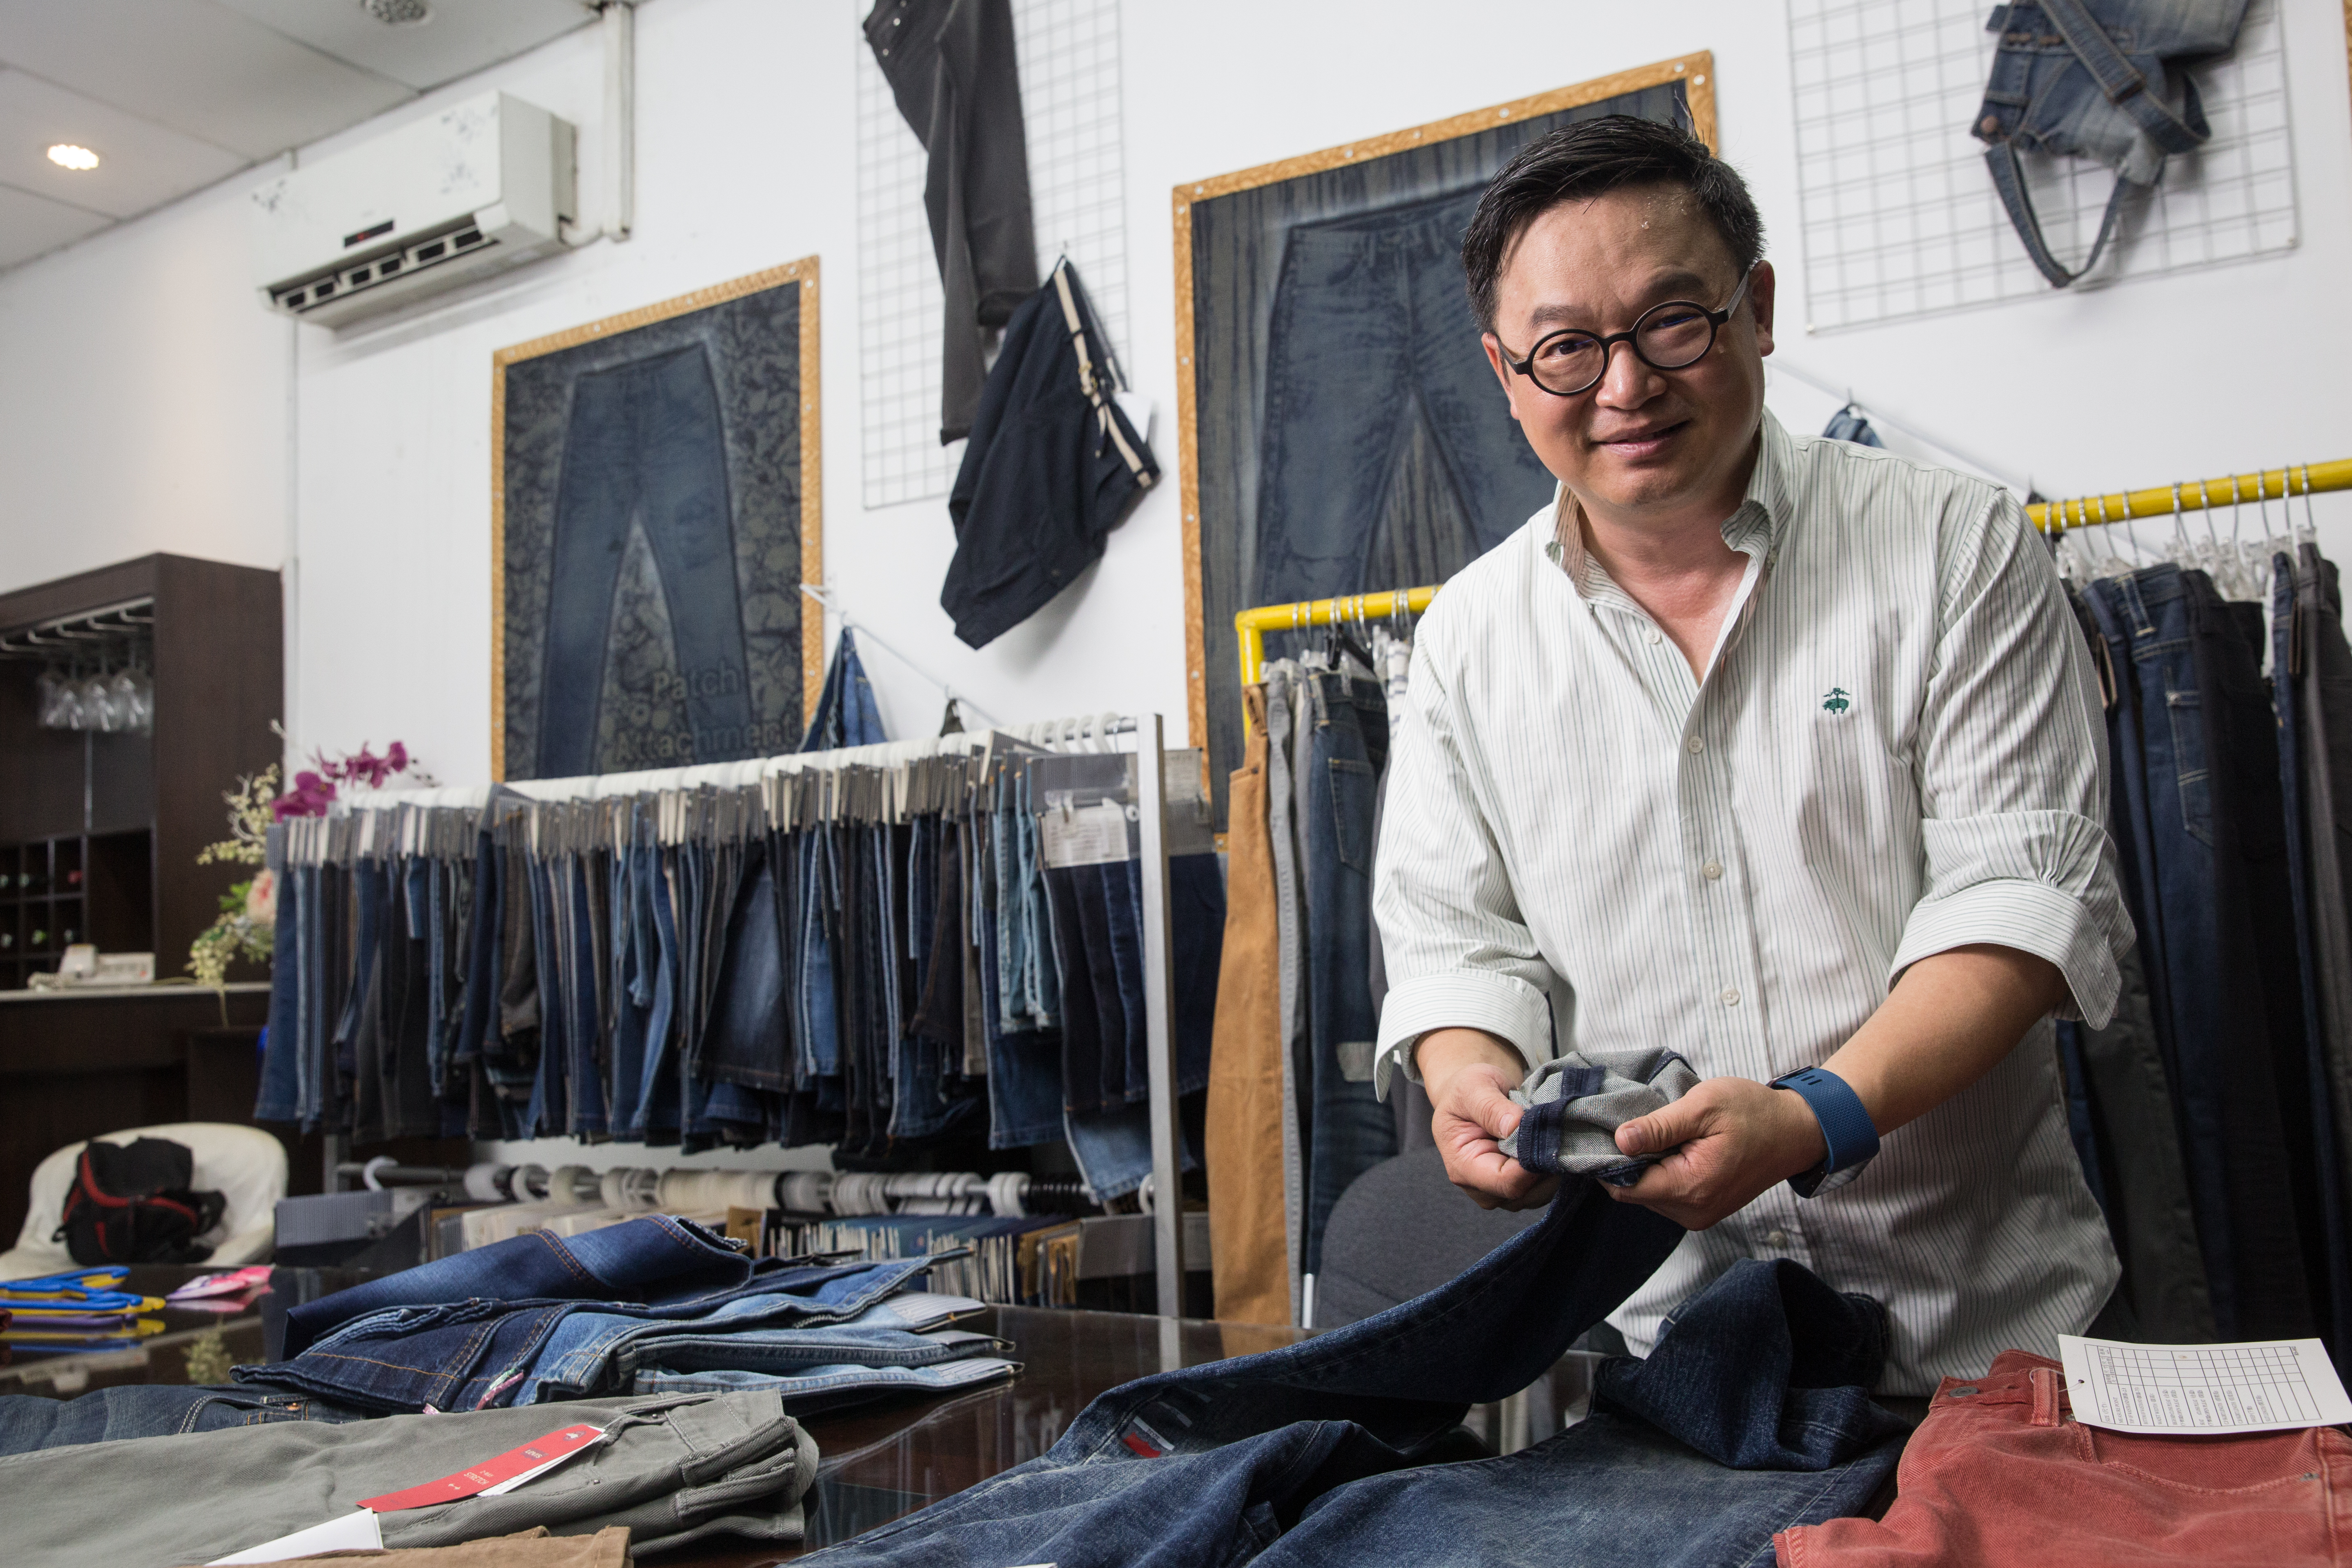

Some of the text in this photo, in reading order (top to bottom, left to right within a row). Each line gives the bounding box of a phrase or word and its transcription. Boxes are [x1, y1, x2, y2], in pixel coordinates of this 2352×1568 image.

[653, 659, 737, 701] Patch
[617, 714, 796, 760] Attachment
[463, 1472, 490, 1485] STRETCH
